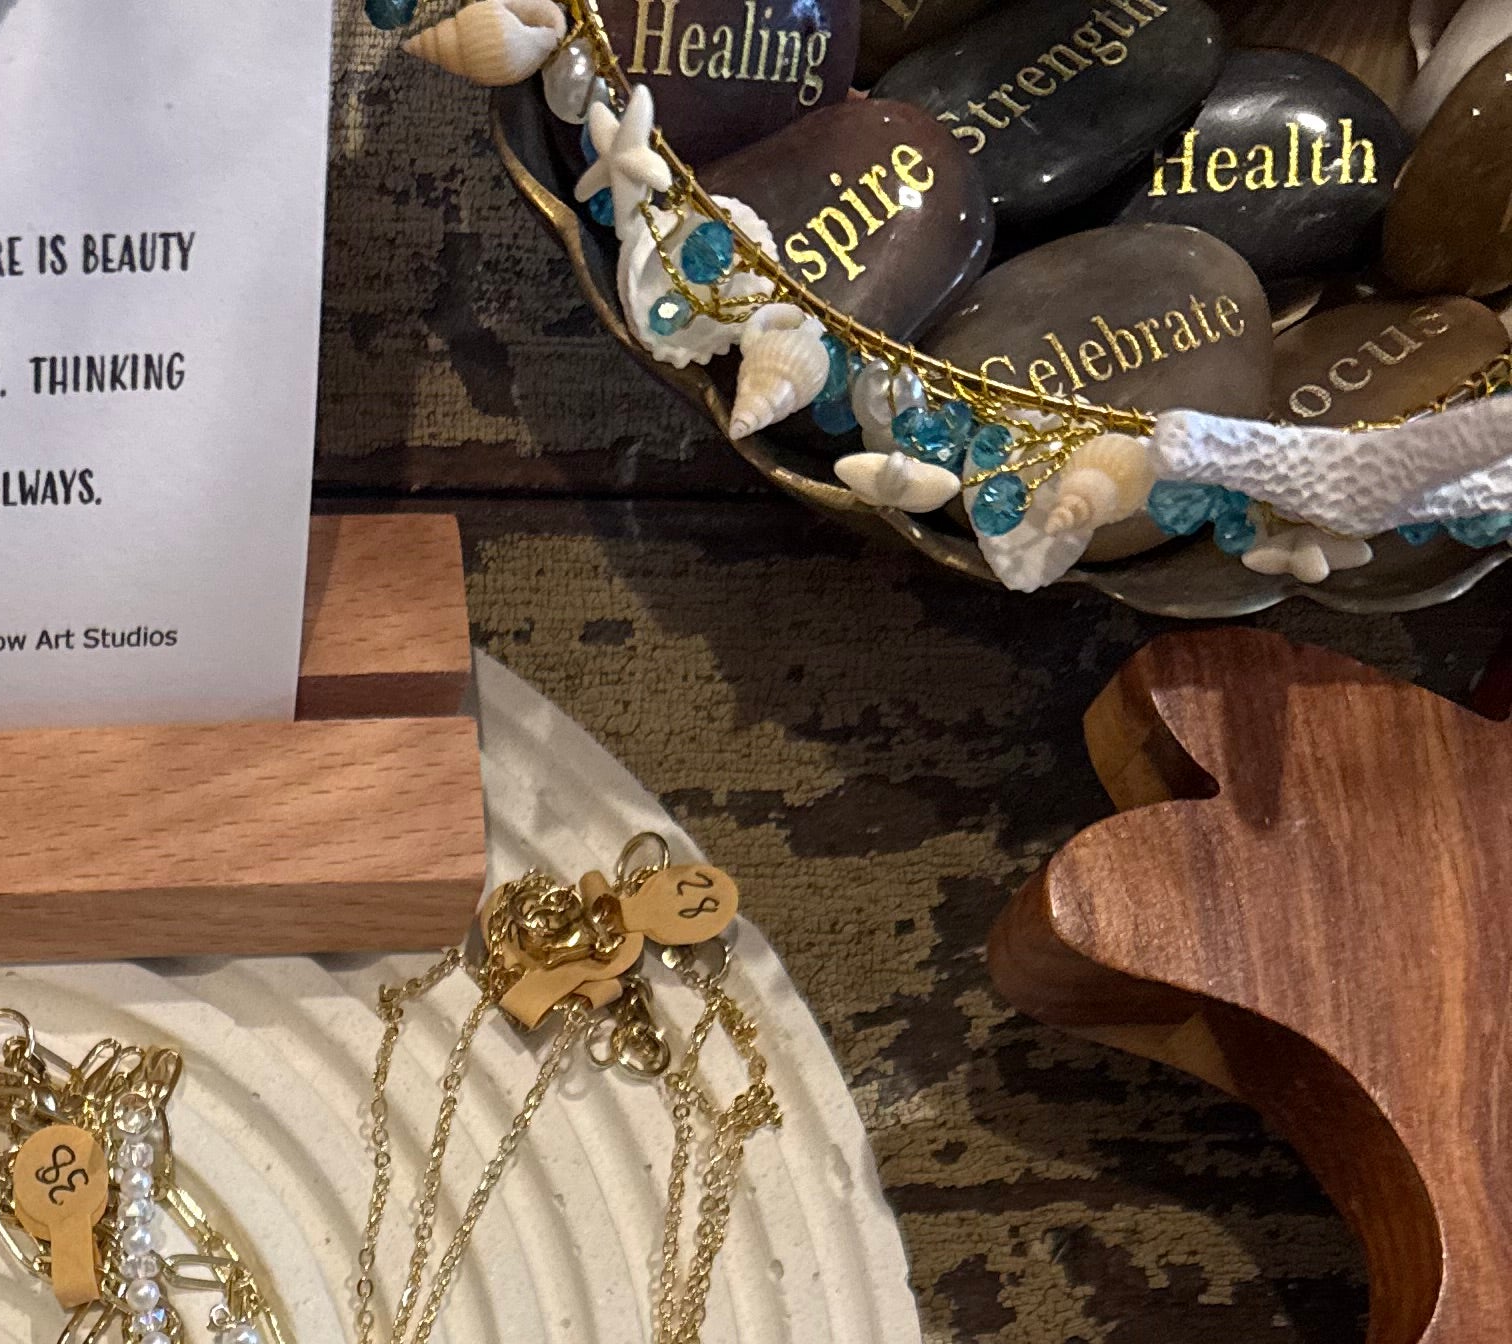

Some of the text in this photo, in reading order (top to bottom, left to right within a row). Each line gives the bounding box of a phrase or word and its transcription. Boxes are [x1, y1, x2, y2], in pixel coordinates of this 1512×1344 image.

[627, 0, 832, 106] Healing
[1147, 117, 1379, 198] Health
[784, 143, 936, 284] spire
[37, 234, 68, 276] IS
[81, 231, 196, 275] BEAUTY
[28, 351, 185, 396] THINKING
[1287, 306, 1452, 420] ocus
[35, 628, 75, 651] Art
[82, 625, 178, 649] Studios
[676, 871, 721, 920] 28
[34, 1144, 90, 1206] 38
